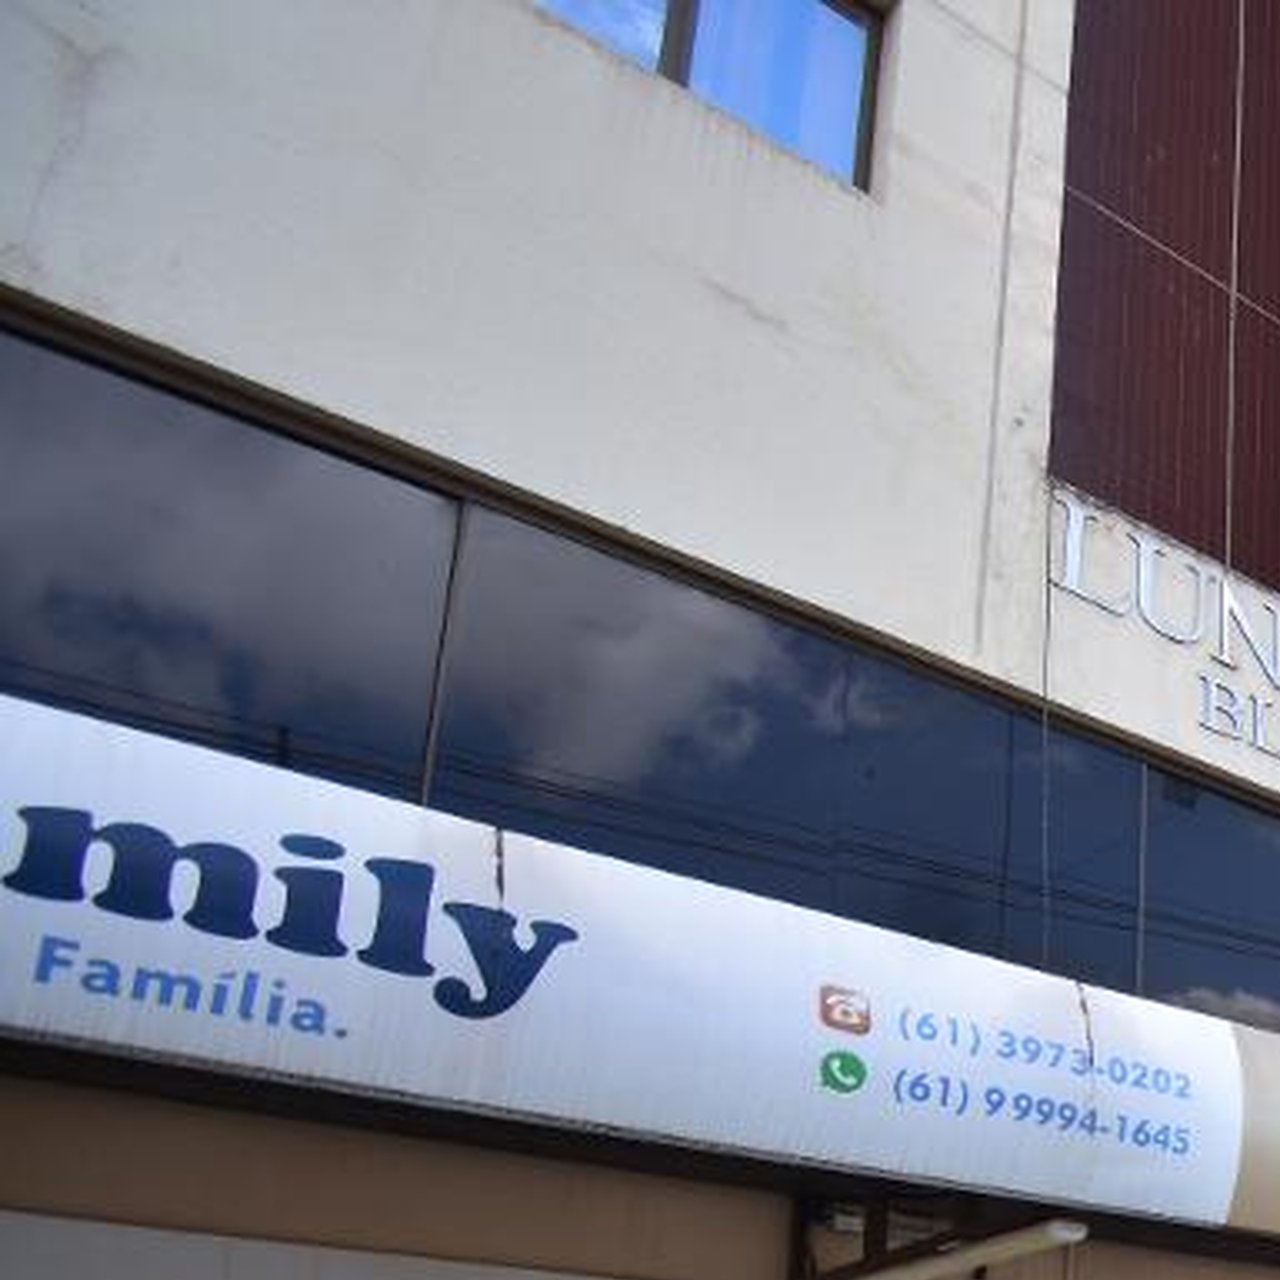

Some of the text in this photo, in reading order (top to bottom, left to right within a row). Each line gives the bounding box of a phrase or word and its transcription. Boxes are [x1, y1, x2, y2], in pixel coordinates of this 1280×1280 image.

[2, 806, 579, 1019] mily
[33, 933, 348, 1039] Família.
[893, 1068, 969, 1116] (61)
[898, 1007, 1193, 1099] (61) 3973-0202
